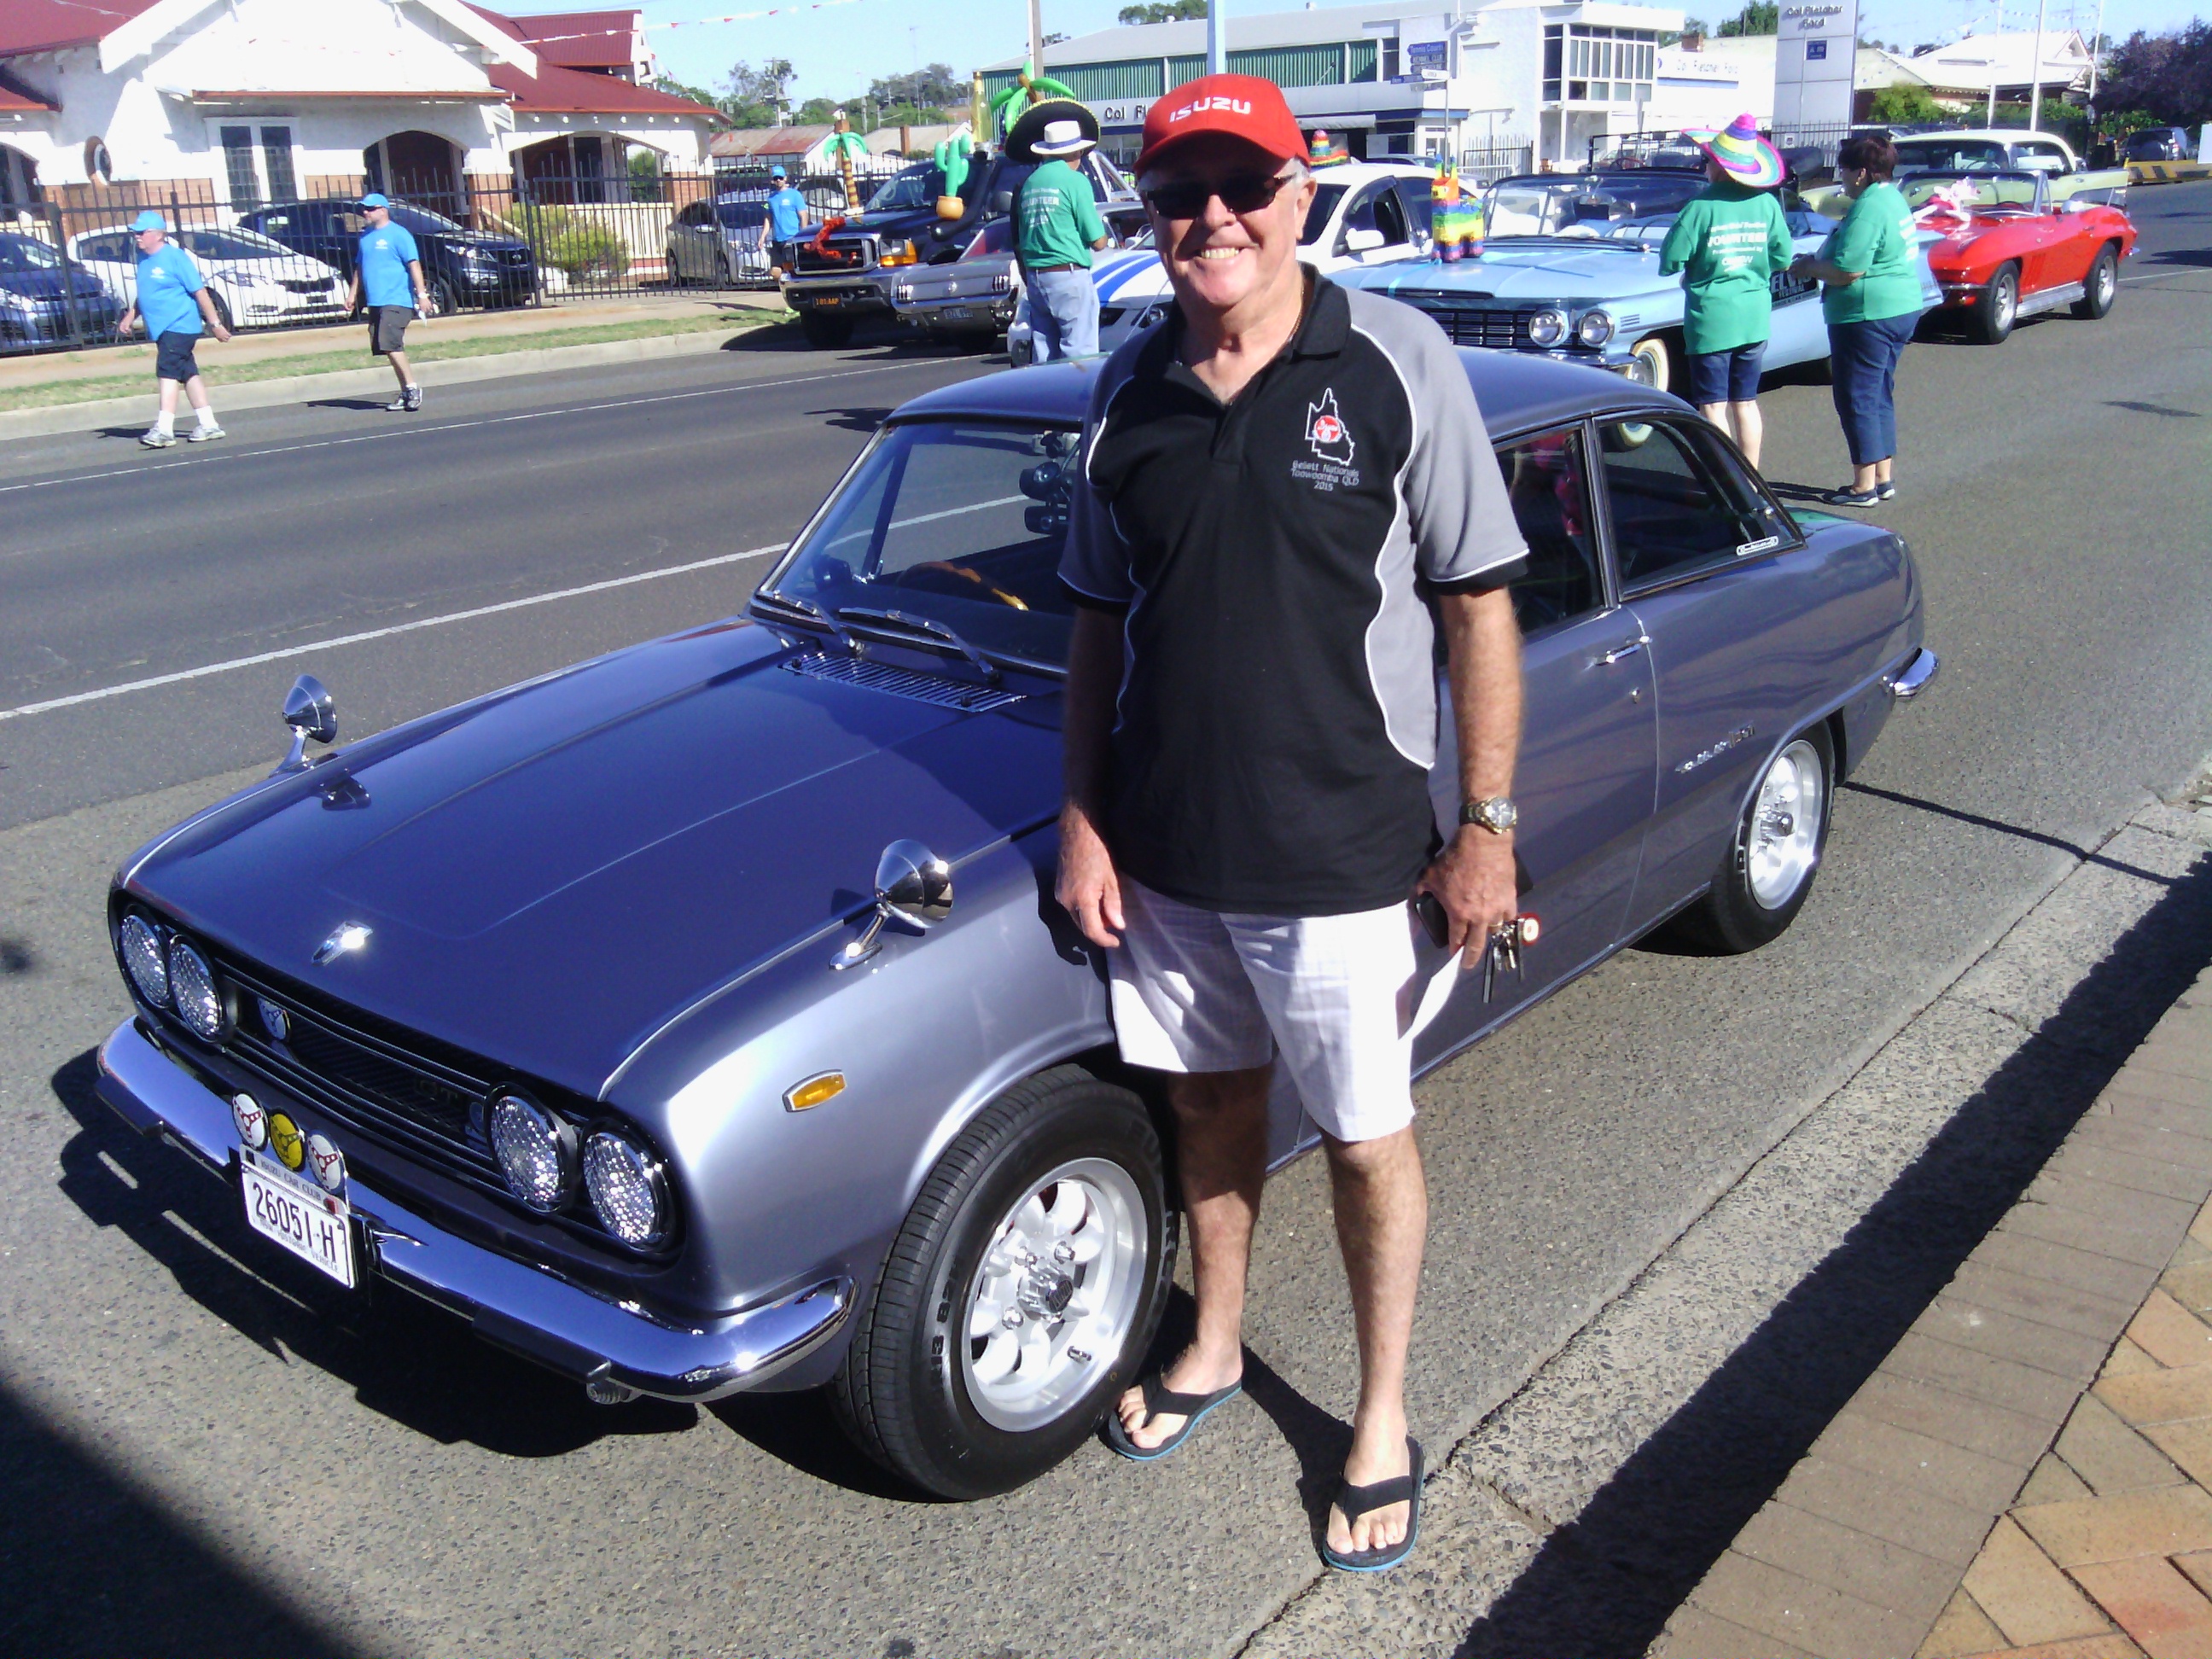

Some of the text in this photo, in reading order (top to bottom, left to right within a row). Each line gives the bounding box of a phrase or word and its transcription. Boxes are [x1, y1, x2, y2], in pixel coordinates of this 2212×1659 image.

[1787, 4, 1842, 15] Col Fletcher
[1802, 16, 1826, 28] Ford
[1104, 105, 1126, 120] Col
[1169, 96, 1251, 123] ISUZU
[1290, 468, 1360, 486] Toowoomba QLD
[1314, 480, 1334, 492] 2015
[260, 1158, 323, 1202] ISUZU CAR CLUB
[311, 1249, 340, 1274] VEHICLE
